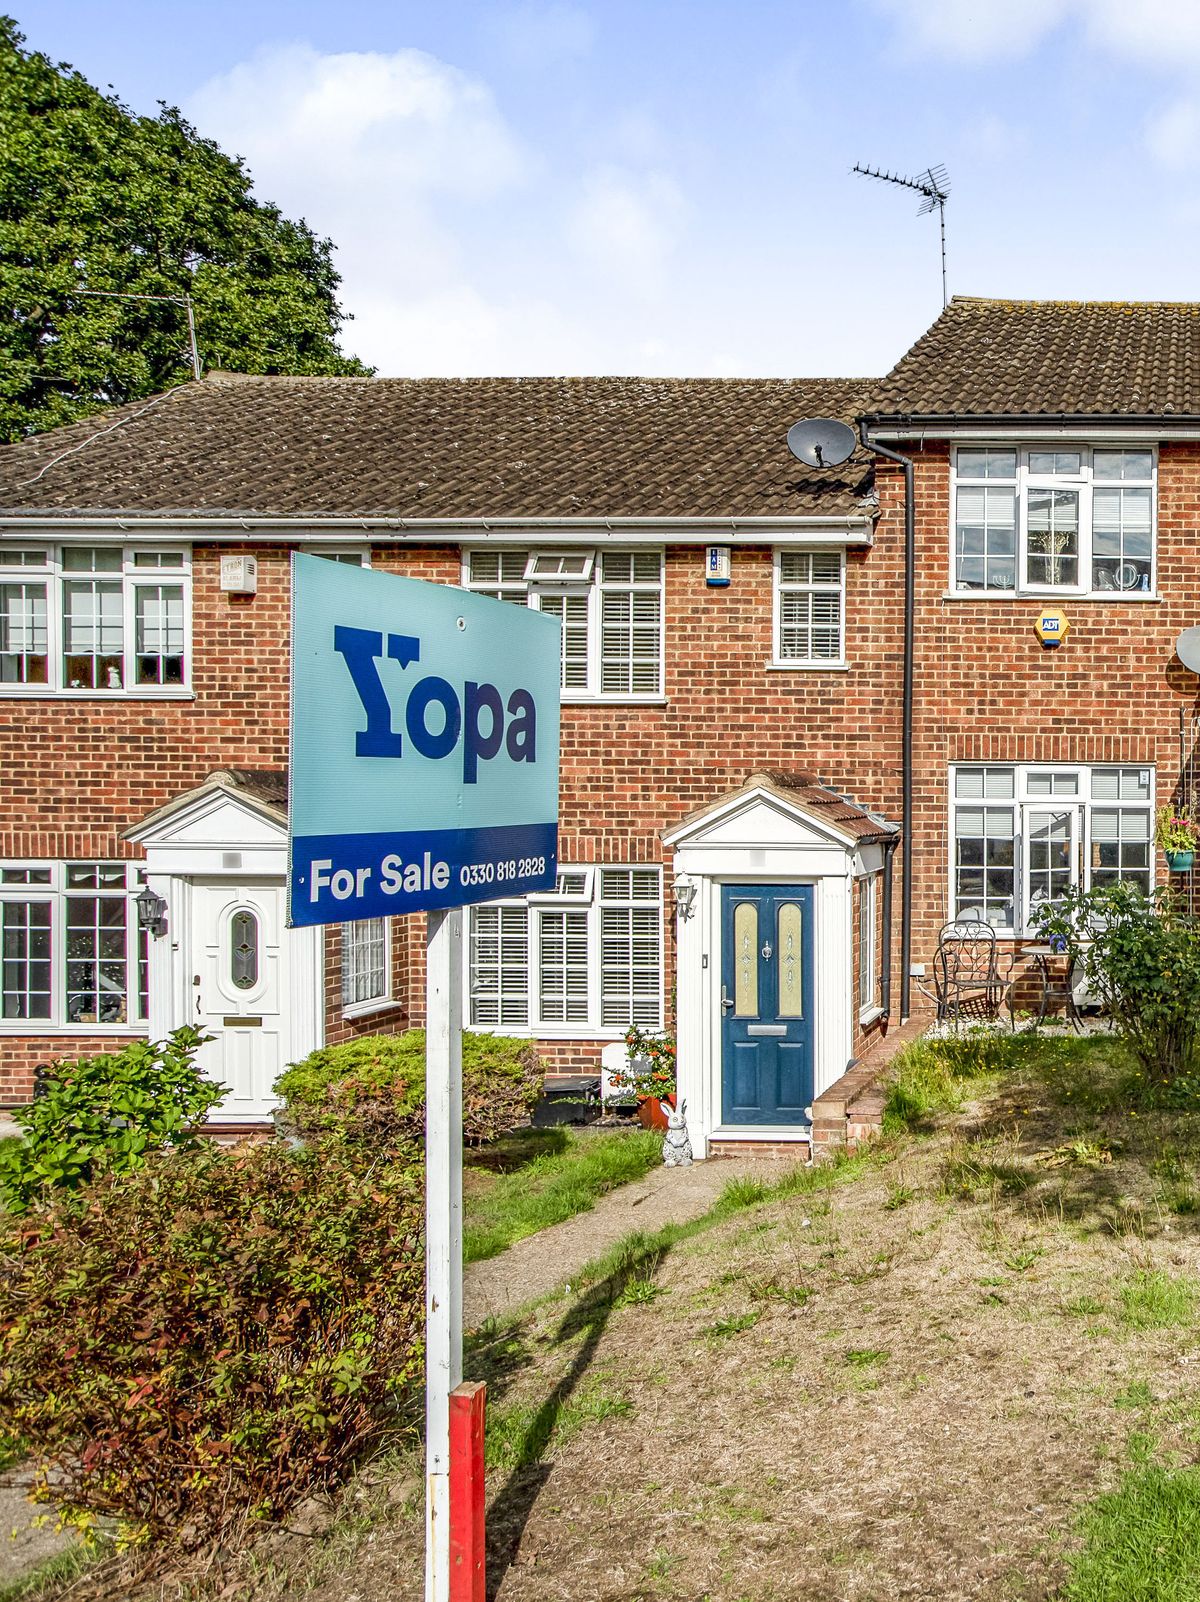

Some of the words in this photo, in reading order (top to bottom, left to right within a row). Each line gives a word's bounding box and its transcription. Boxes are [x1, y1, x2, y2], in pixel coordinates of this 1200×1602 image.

[1042, 619, 1059, 630] ADT
[334, 625, 537, 784] Yopa
[310, 859, 371, 902] For
[380, 852, 450, 895] Sale
[460, 863, 493, 887] 0330
[497, 860, 516, 881] 818
[518, 856, 546, 879] 2828
